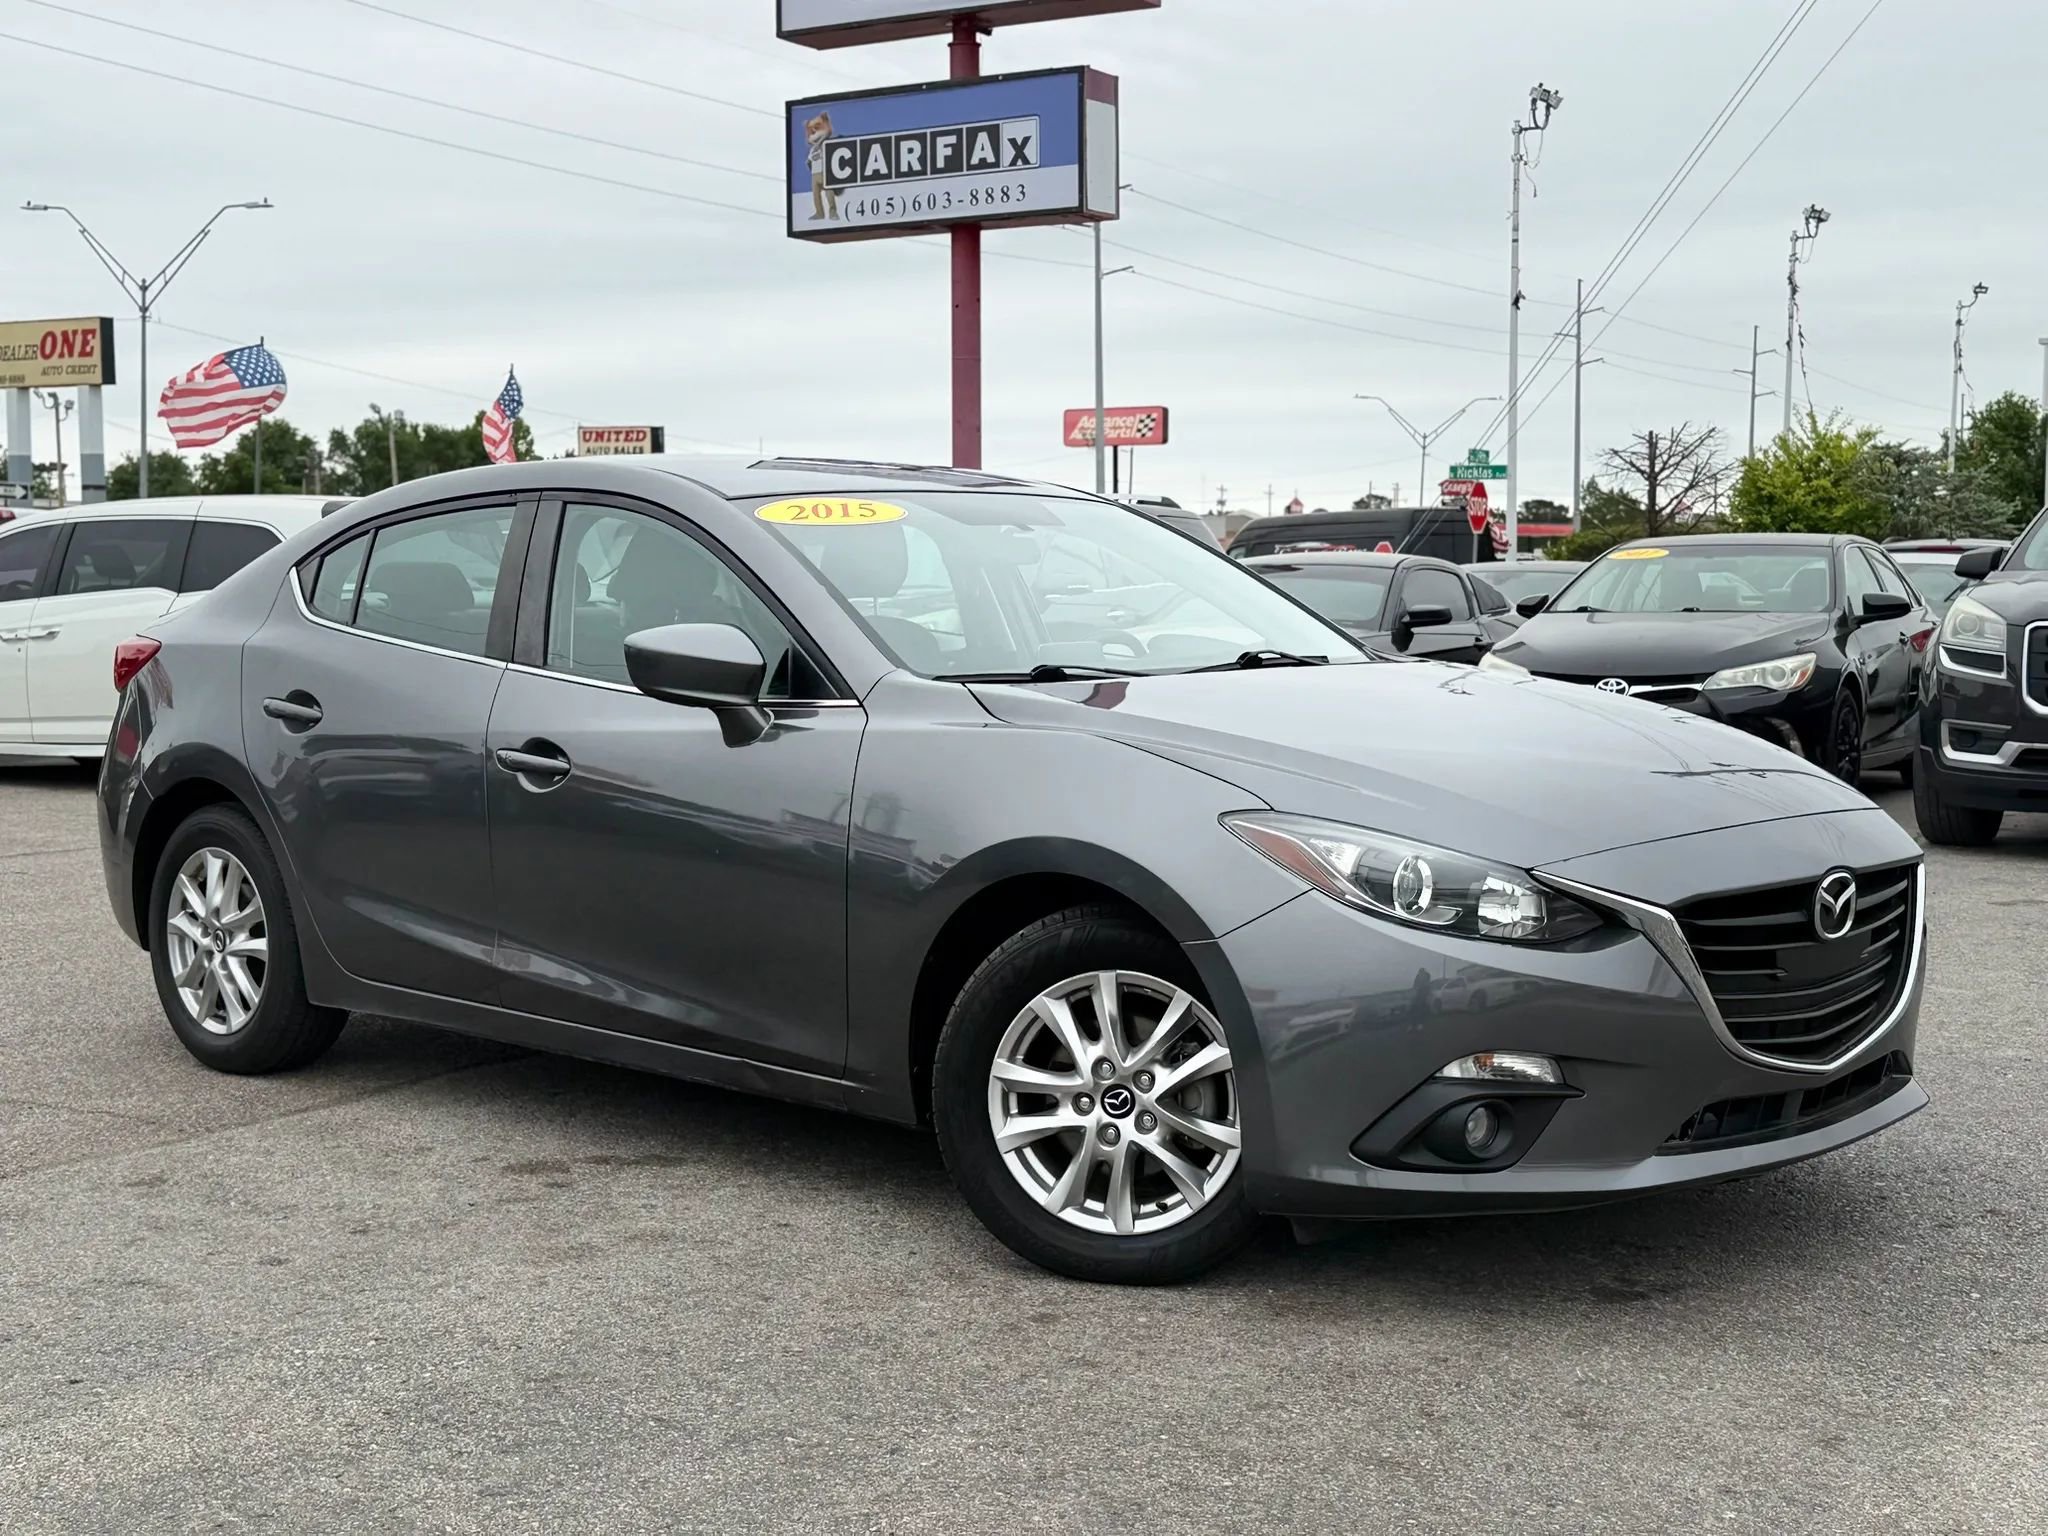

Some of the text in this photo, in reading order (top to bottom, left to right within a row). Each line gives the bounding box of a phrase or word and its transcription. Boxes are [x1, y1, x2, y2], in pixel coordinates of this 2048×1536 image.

[830, 131, 1033, 180] CARFAX
[844, 183, 1027, 221] (405)603-8883
[40, 328, 97, 360] ONE
[41, 363, 98, 376] AUTO CREDIT
[1076, 414, 1135, 428] Adance
[582, 429, 647, 443] UNITED
[585, 445, 644, 456] AUTO SALES
[786, 502, 877, 521] 2015
[1469, 497, 1487, 516] STOP
